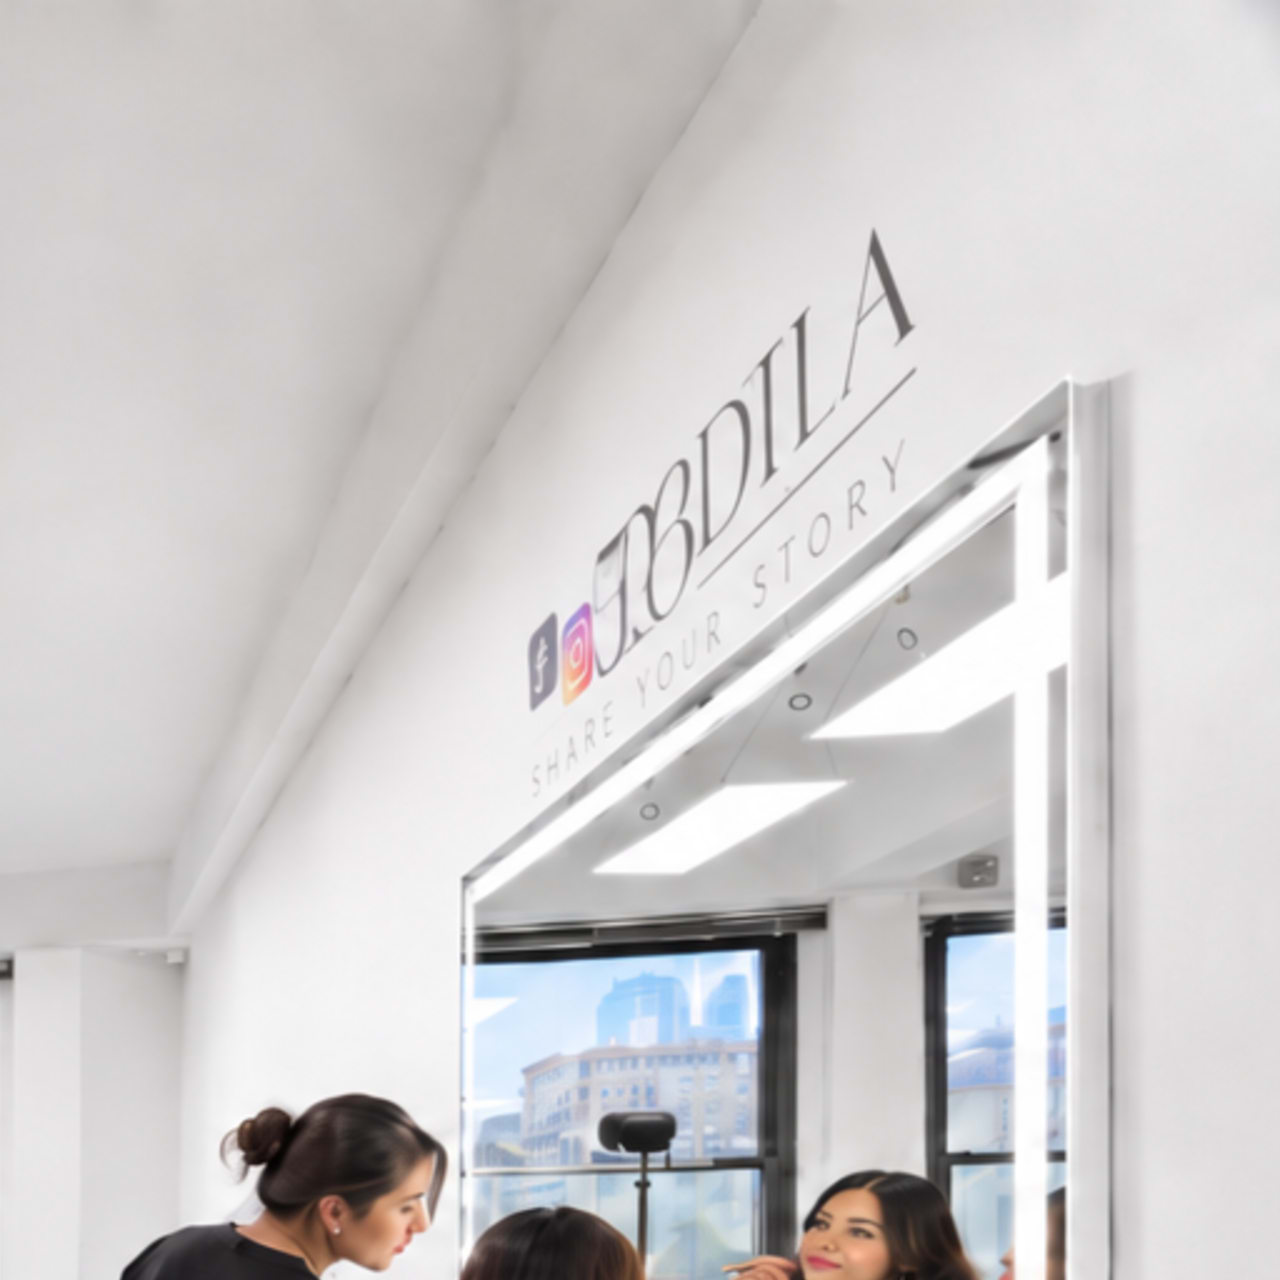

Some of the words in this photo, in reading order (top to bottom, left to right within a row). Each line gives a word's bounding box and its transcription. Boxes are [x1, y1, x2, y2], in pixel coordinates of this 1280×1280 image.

[531, 699, 614, 798] SHARE
[636, 610, 721, 708] YOUR
[752, 438, 906, 609] STORY
